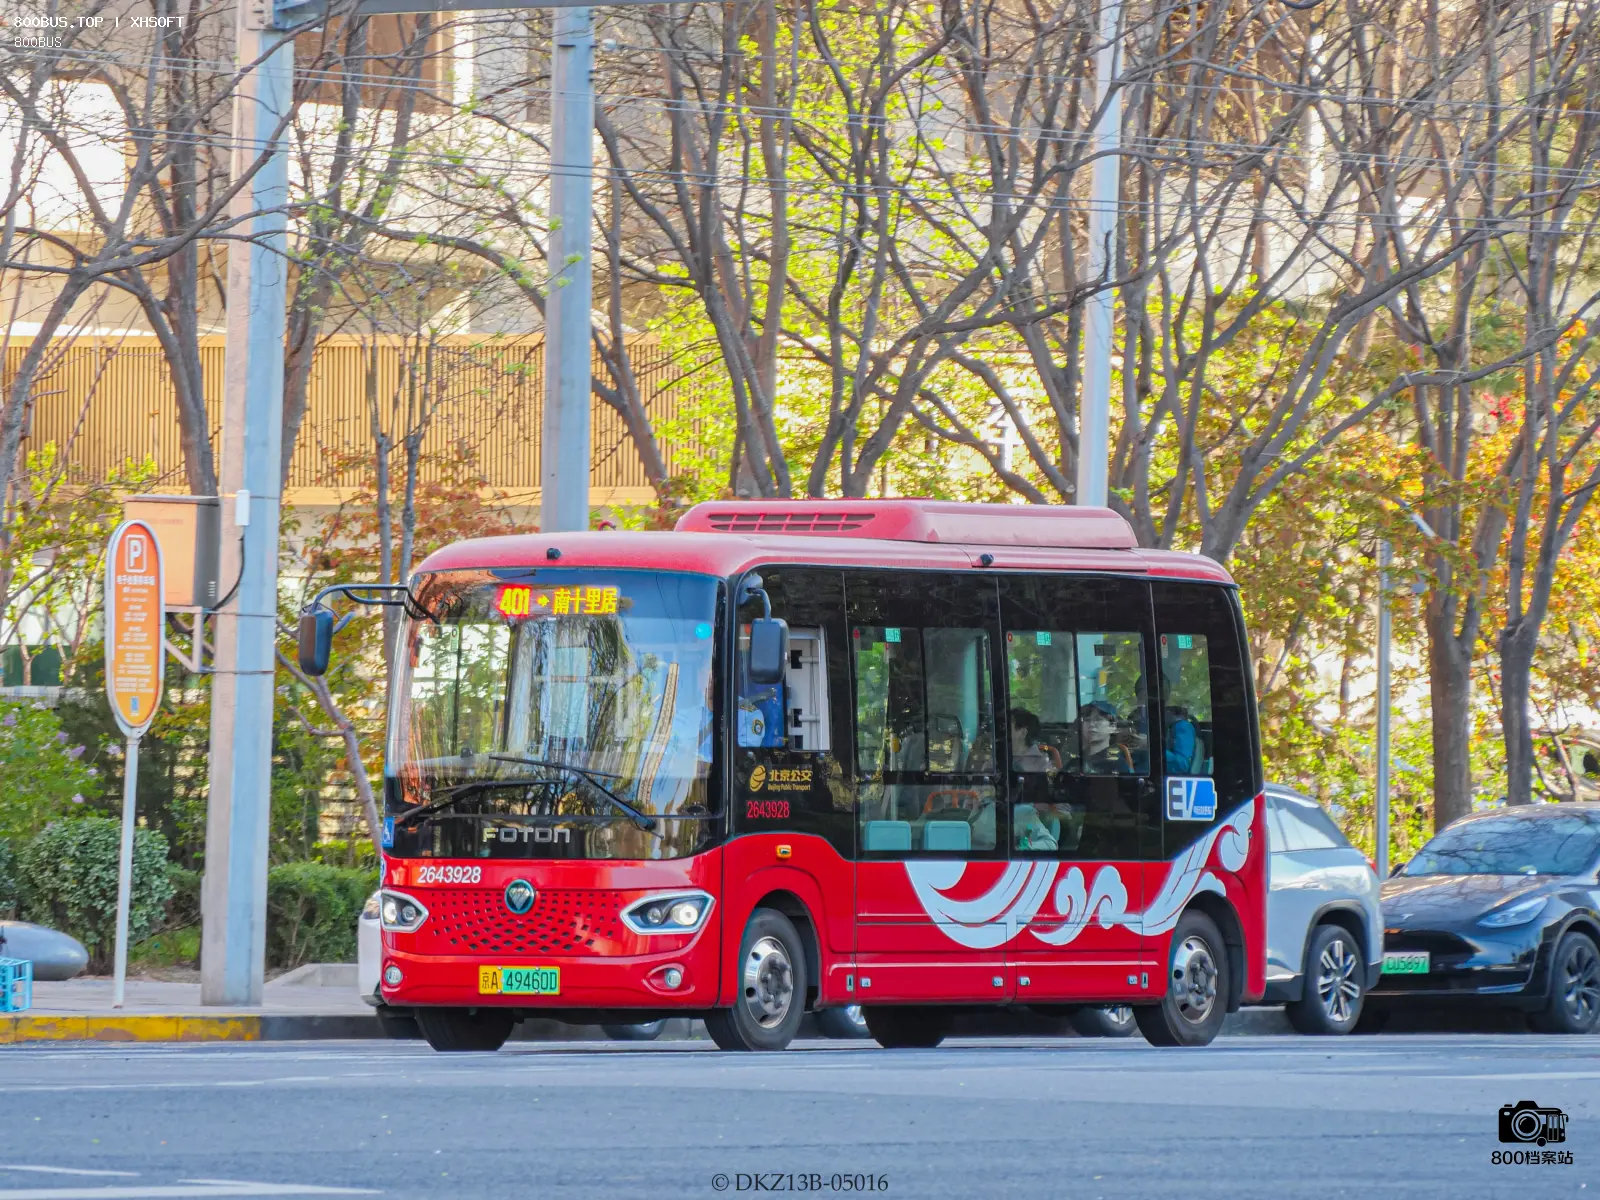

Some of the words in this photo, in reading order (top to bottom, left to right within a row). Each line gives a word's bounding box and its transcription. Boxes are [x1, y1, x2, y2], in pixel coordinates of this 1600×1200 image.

[129, 540, 142, 568] P
[500, 588, 531, 615] 401
[552, 586, 618, 615] 南十里居
[768, 769, 814, 782] 北京公交
[746, 800, 790, 819] 2643928
[482, 827, 571, 844] FOTON
[417, 866, 482, 884] 2643928
